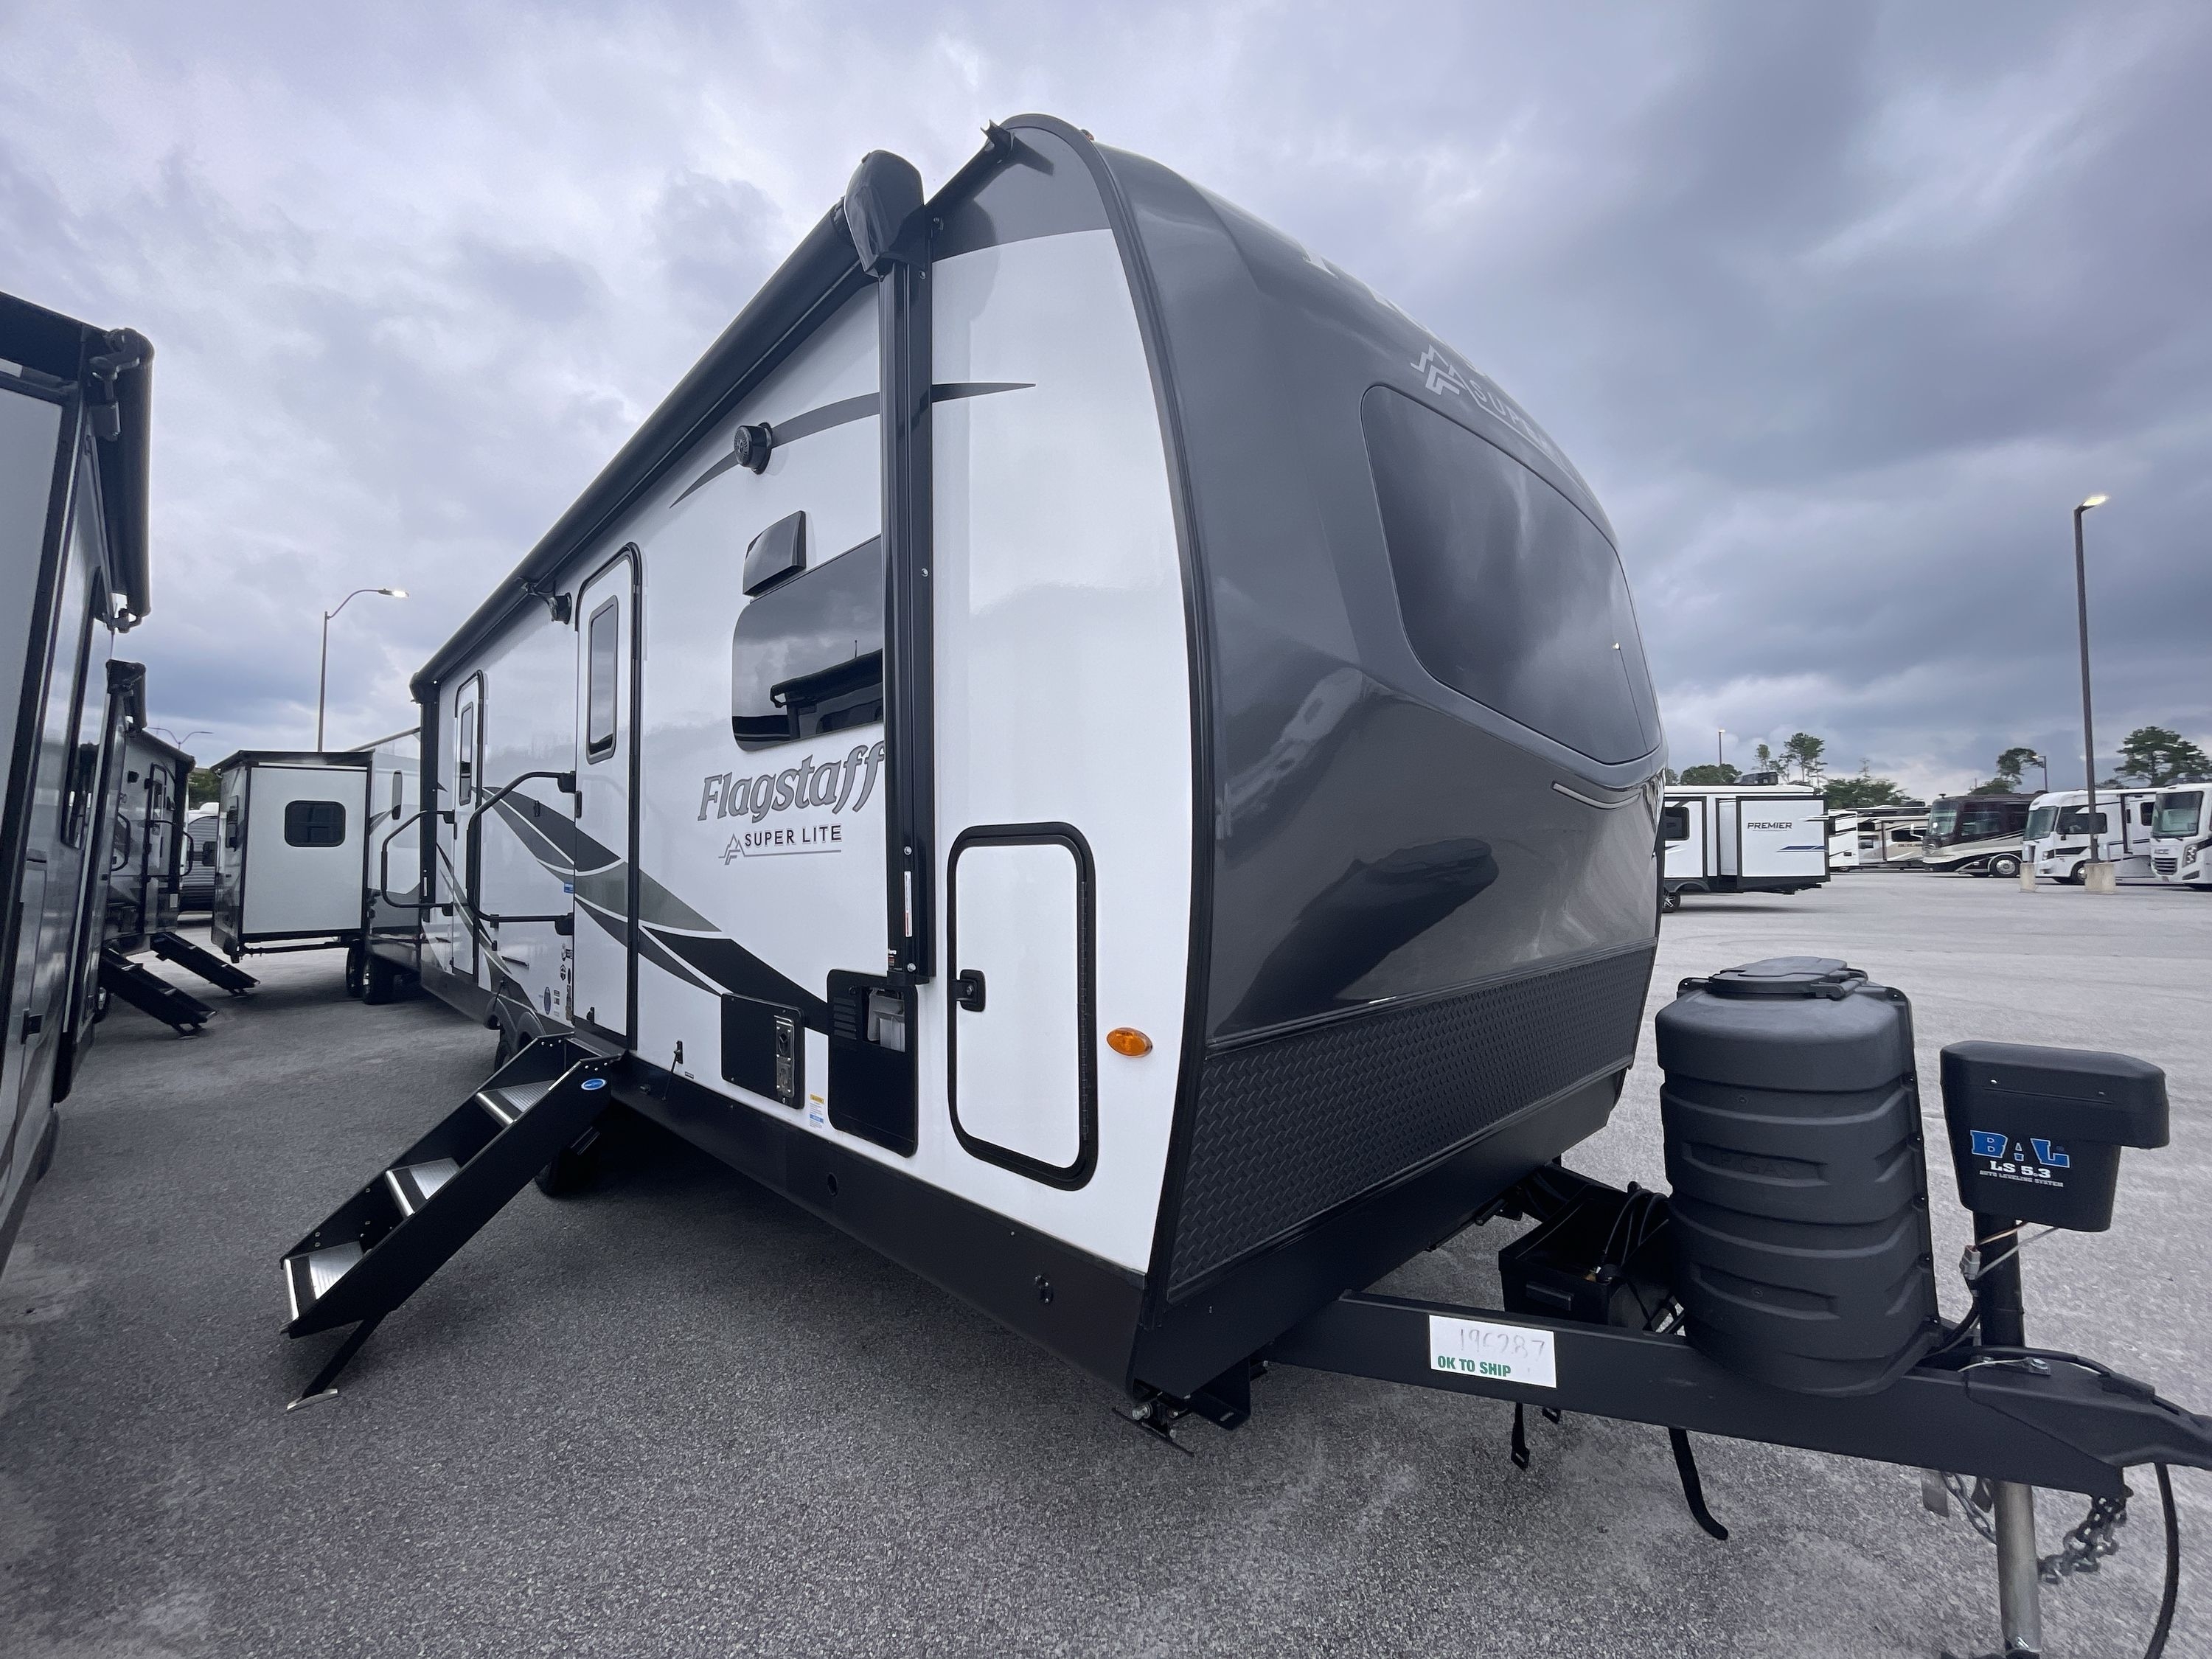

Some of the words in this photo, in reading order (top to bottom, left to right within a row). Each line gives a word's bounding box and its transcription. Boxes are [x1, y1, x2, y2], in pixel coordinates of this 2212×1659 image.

[697, 740, 885, 824] Flagstaff
[744, 829, 796, 847] SUPER
[801, 824, 843, 844] LITE
[1747, 821, 1792, 830] PREMIER
[1989, 1160, 2016, 1173] LS
[2020, 1165, 2051, 1178] 5.3
[2034, 1178, 2064, 1188] SYSTEM
[1437, 1355, 1456, 1370] OK
[1458, 1358, 1475, 1373] TO
[1479, 1361, 1512, 1377] SHIP
